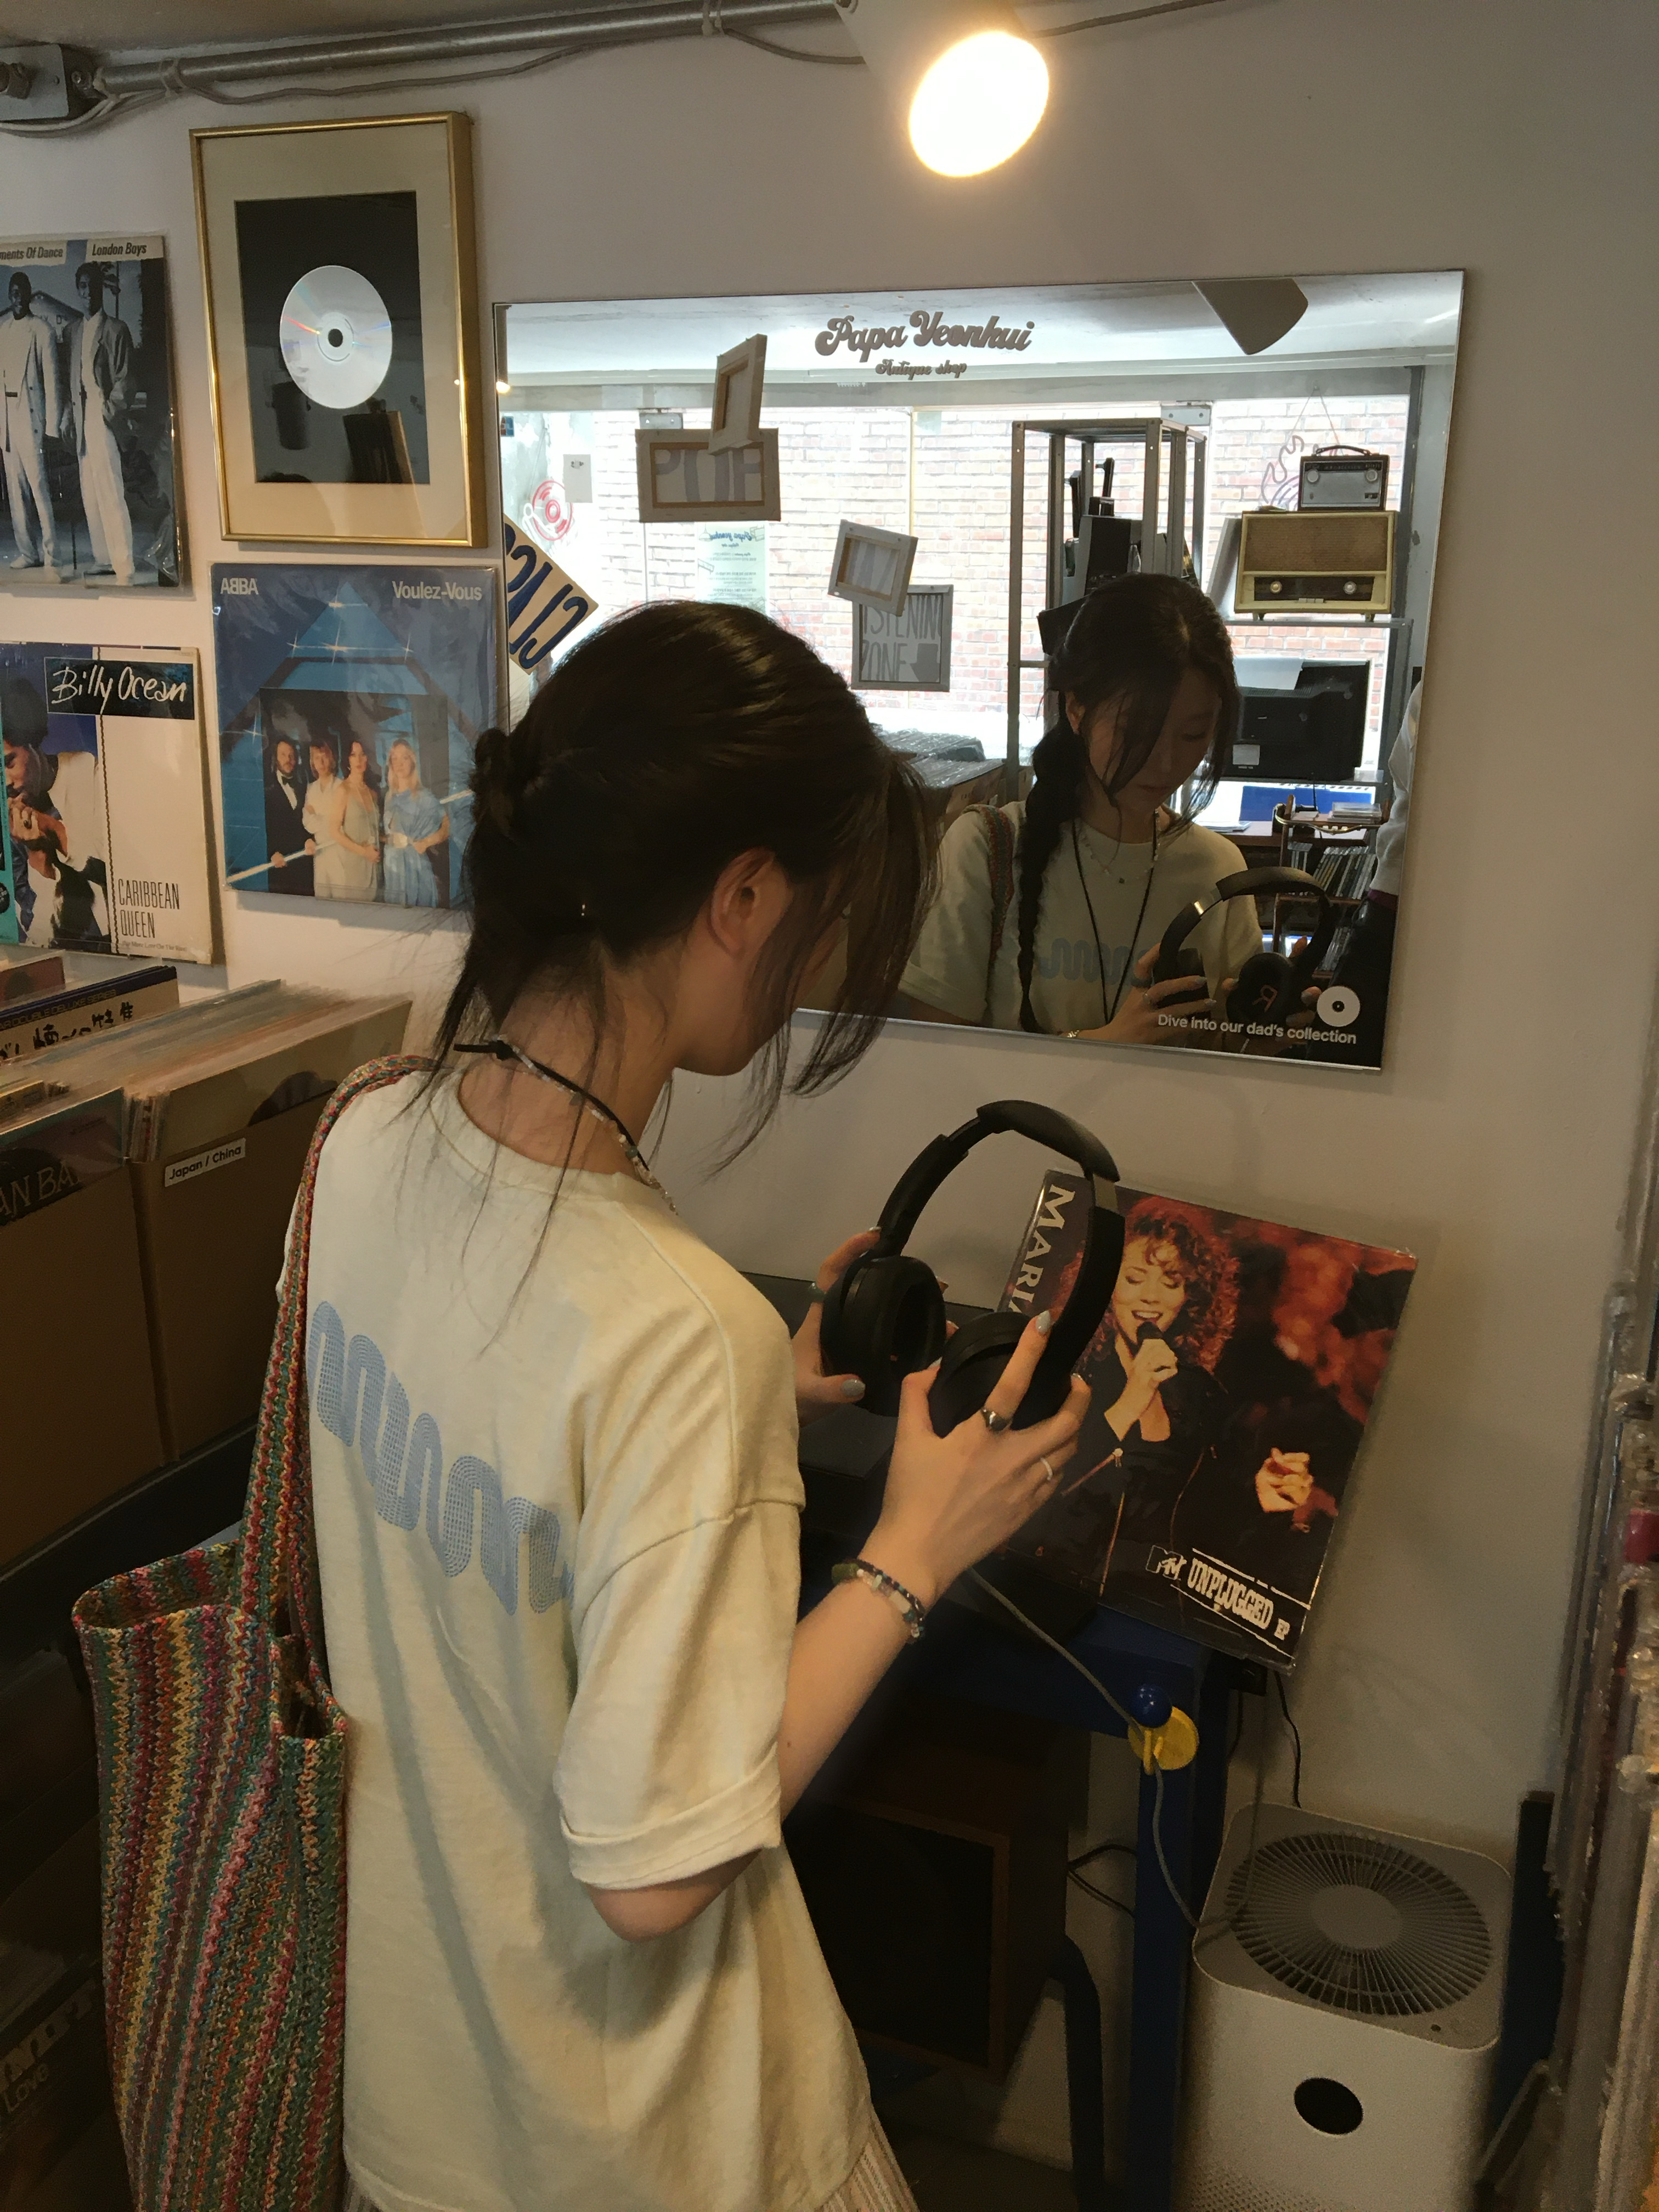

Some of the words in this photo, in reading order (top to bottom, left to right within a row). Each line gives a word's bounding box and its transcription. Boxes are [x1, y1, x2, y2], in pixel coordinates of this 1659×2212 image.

[26, 247, 36, 259] Of
[38, 247, 63, 258] Dance
[92, 243, 123, 256] London
[126, 242, 147, 257] Boys
[815, 315, 909, 363] Papa
[909, 310, 1035, 351] Yeonhui
[876, 359, 932, 380] Antique
[935, 360, 967, 378] shop
[220, 578, 259, 595] ABBA
[392, 580, 482, 601] Voulez-Vous
[51, 664, 113, 714] Billy
[118, 667, 187, 702] Ocean
[118, 878, 179, 910] CARIBBEAN
[120, 910, 155, 938] QUEEN
[51, 999, 86, 1015] DELUXE
[87, 989, 117, 1003] SERIES
[1158, 1014, 1188, 1028] Dive
[1191, 1016, 1217, 1031] into
[1220, 1021, 1244, 1033] our
[1246, 1022, 1284, 1037] dad's
[1287, 1026, 1357, 1044] collection
[169, 1160, 202, 1180] Japan
[212, 1146, 241, 1164] China
[1187, 1558, 1273, 1630] UNPLUGGED
